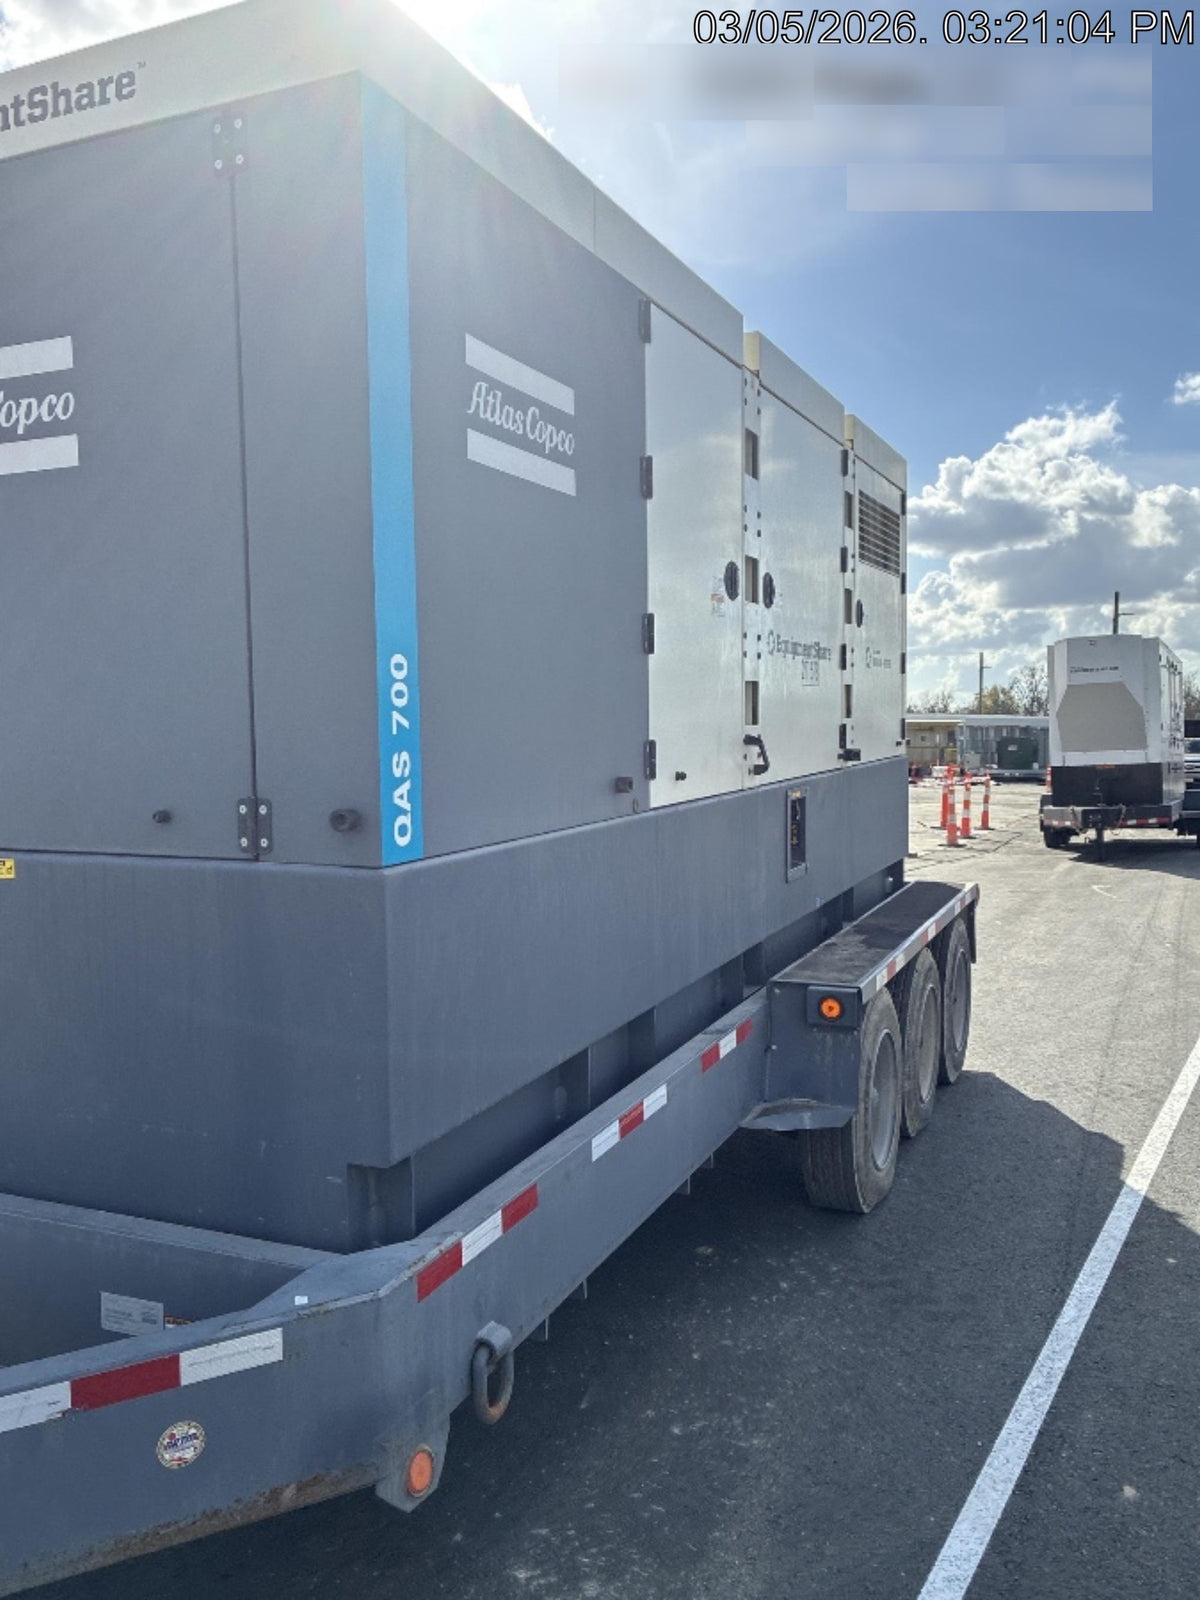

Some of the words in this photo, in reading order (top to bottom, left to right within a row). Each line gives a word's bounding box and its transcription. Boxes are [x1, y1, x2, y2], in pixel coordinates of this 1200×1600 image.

[0, 390, 75, 434] opco
[466, 381, 524, 435] Atlas
[525, 406, 575, 456] Copco
[390, 653, 410, 735] 700
[393, 750, 412, 847] QAS
